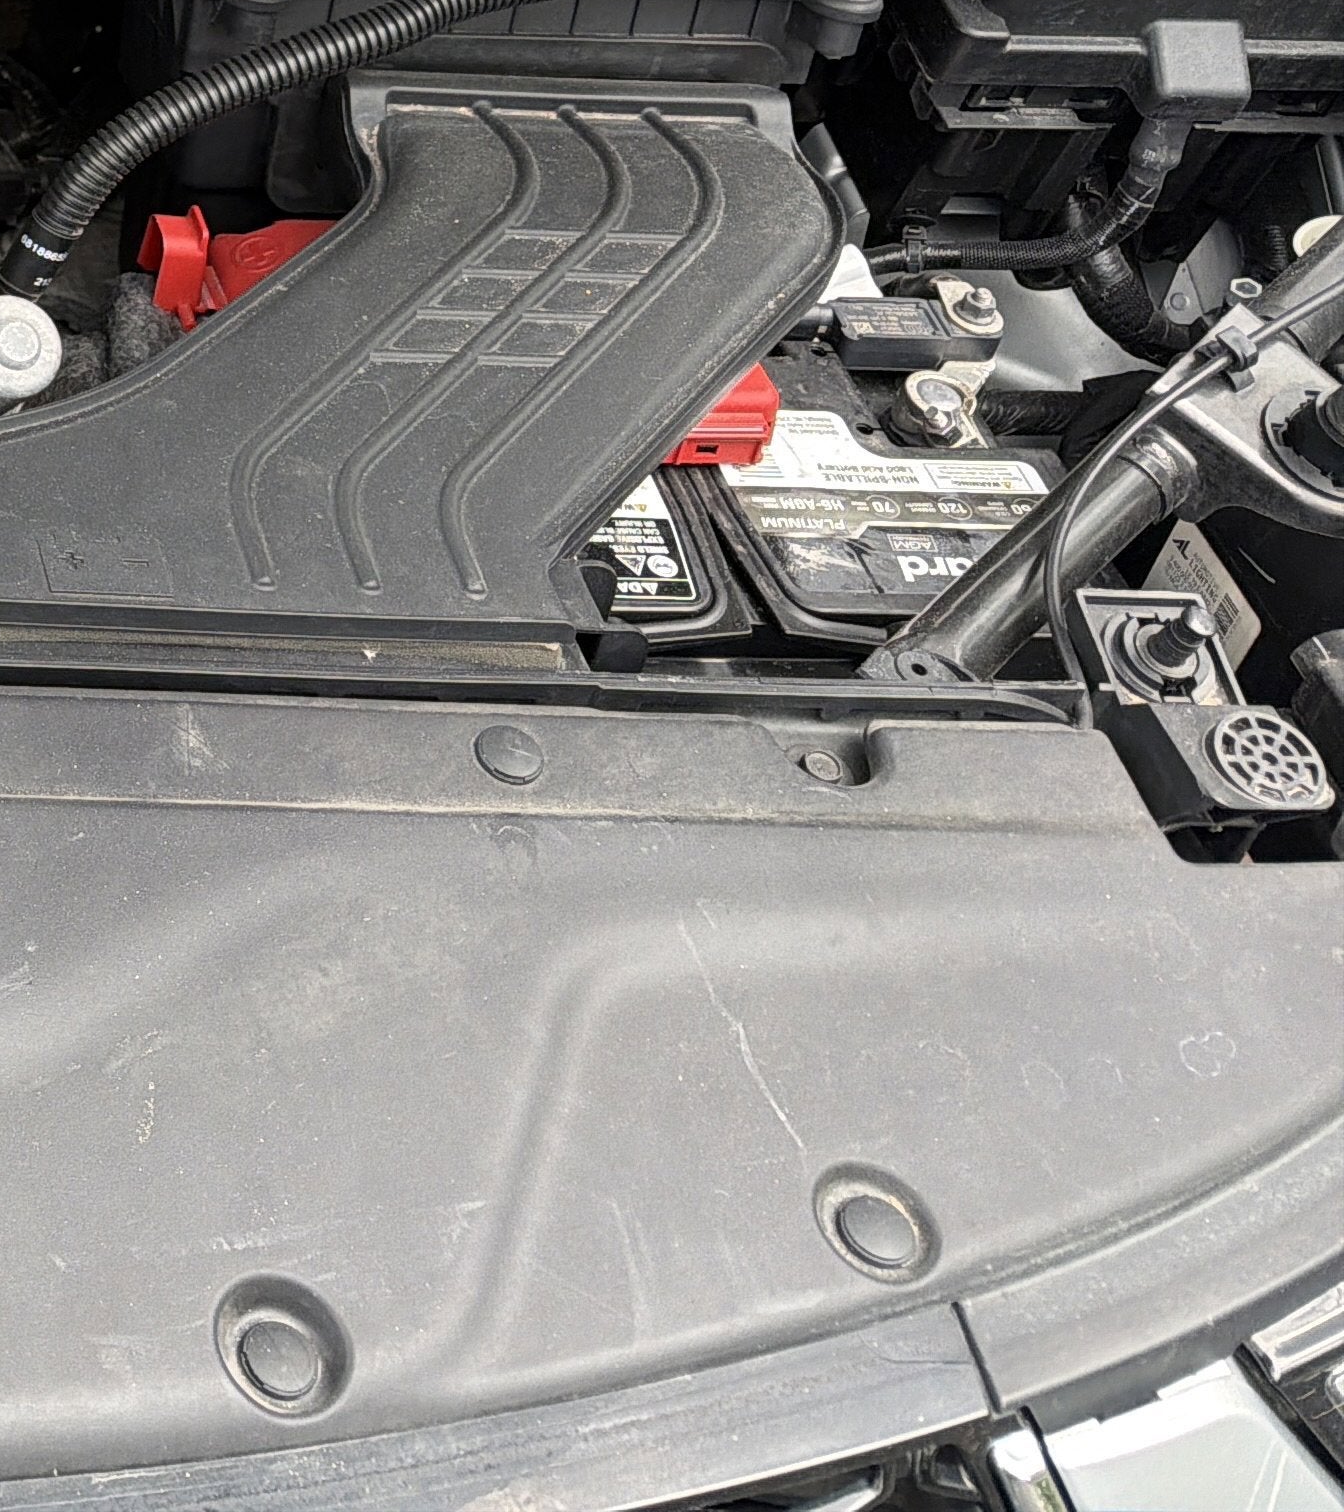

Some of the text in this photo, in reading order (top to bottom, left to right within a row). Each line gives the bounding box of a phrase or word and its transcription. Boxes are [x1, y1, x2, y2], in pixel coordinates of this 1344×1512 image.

[822, 472, 920, 485] NON-SPILLABLE
[872, 500, 895, 514] 70
[938, 502, 967, 515] 120
[761, 516, 847, 530] PLATINUM
[892, 540, 932, 551] AGM
